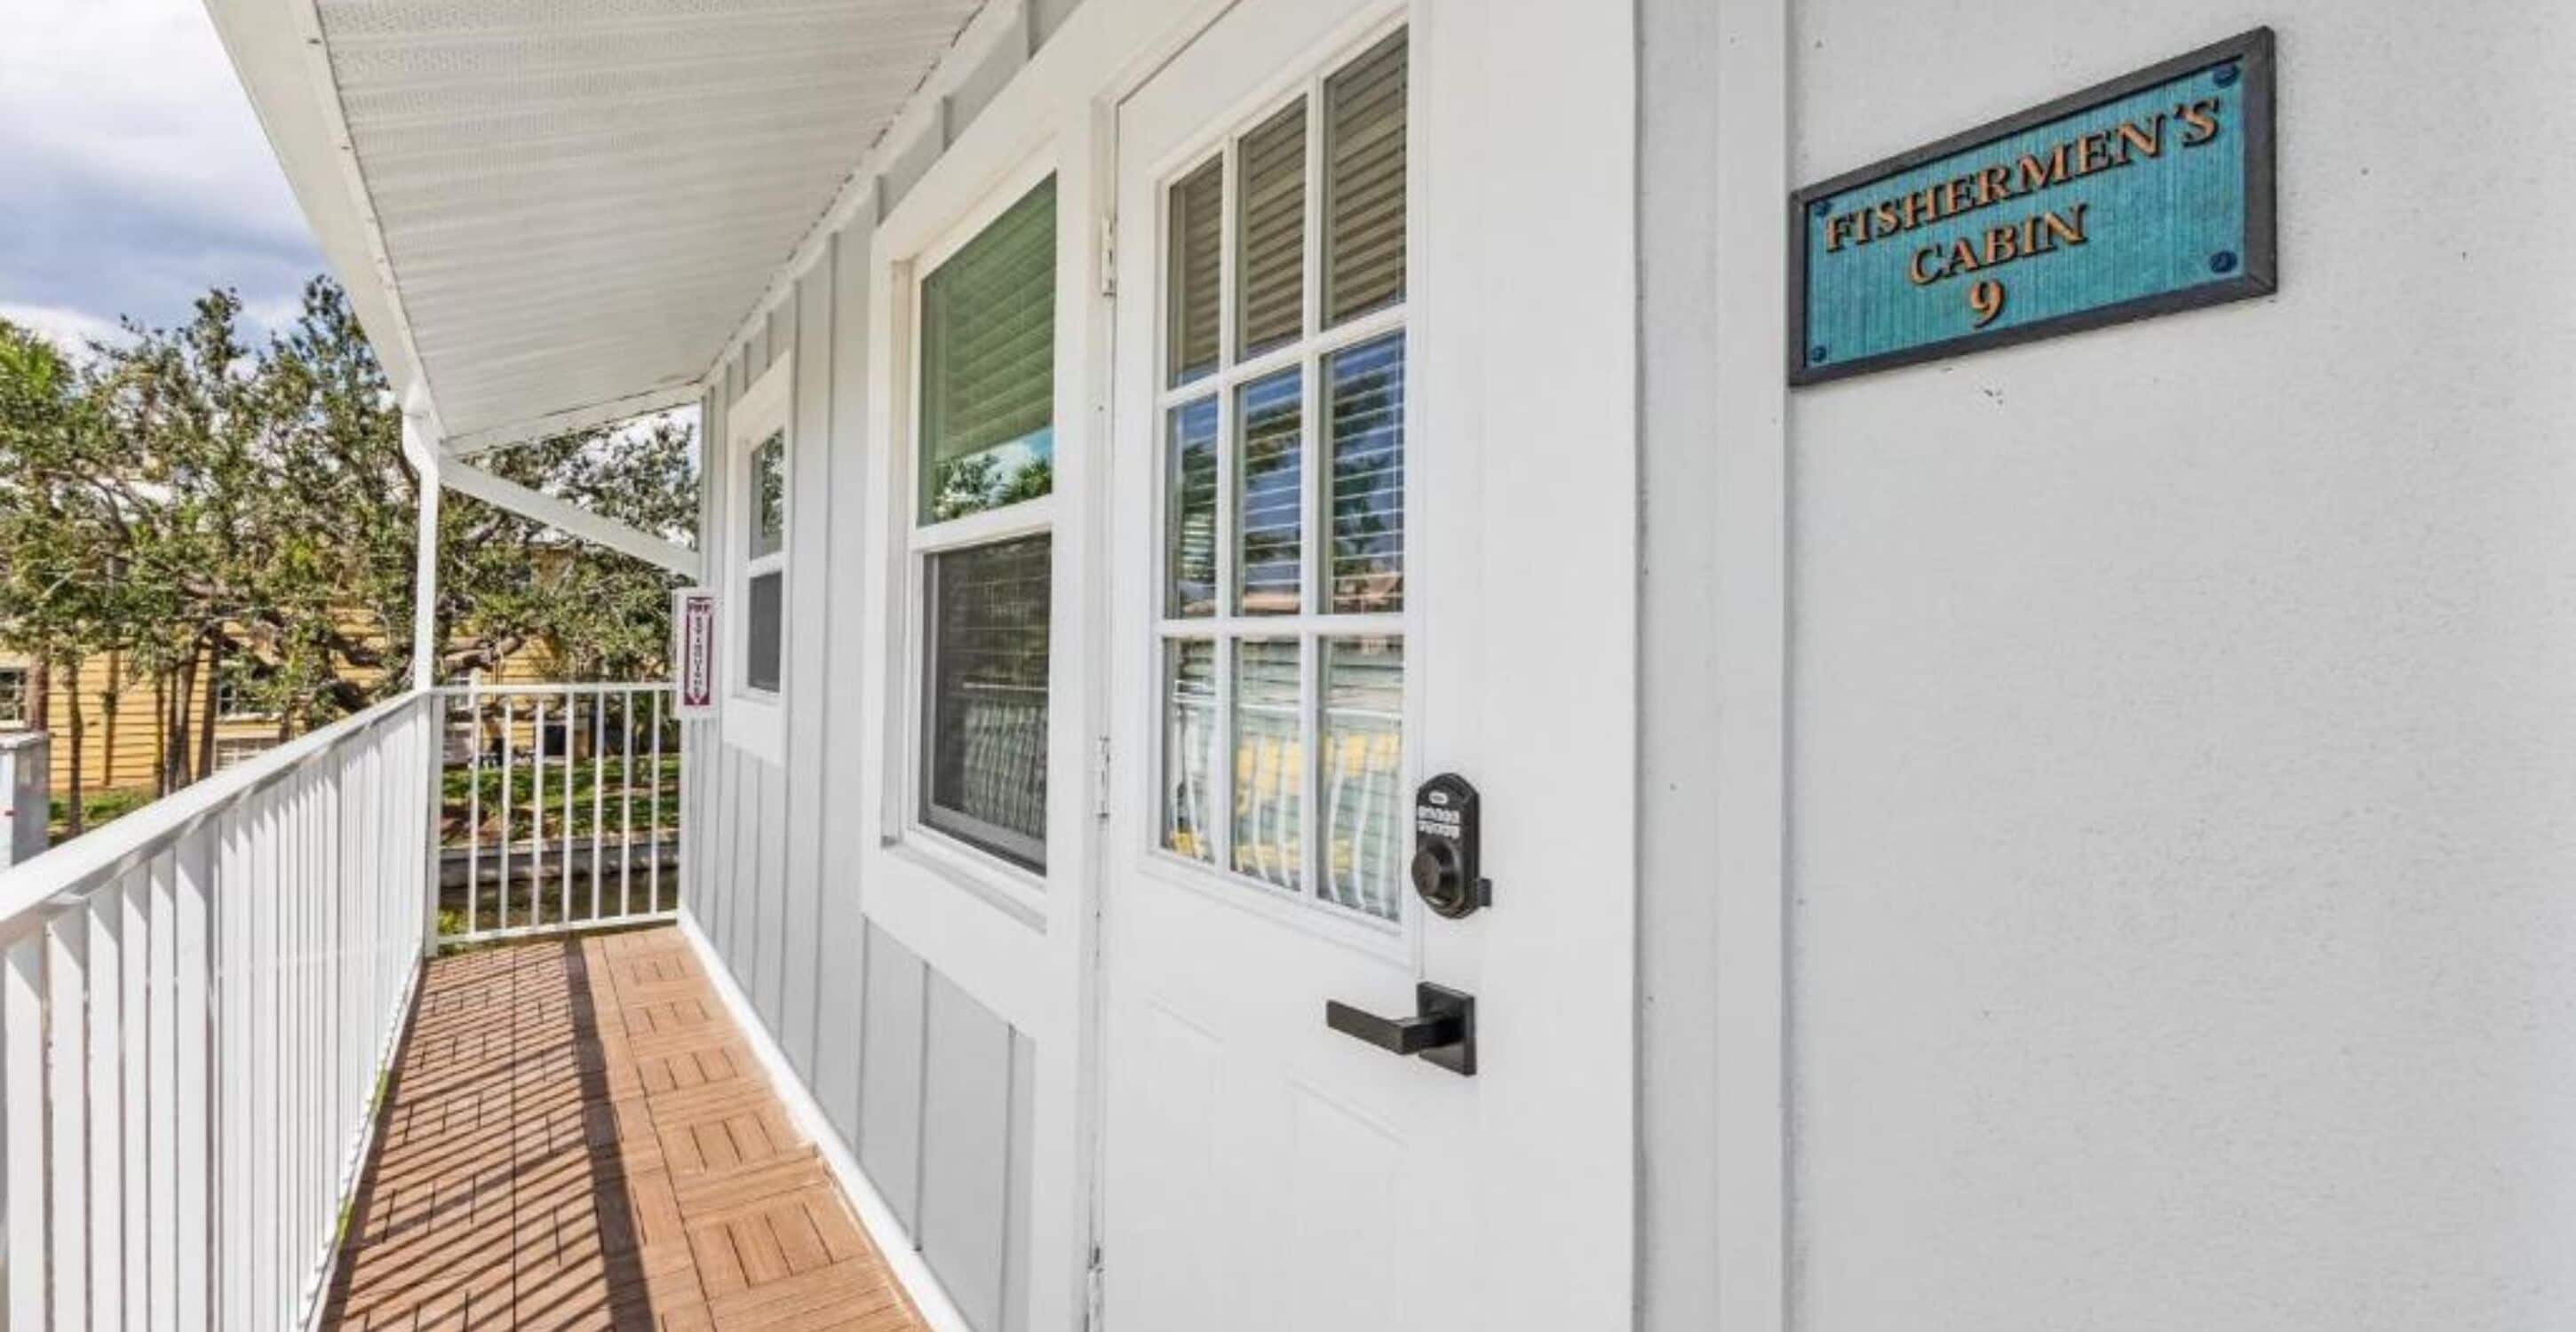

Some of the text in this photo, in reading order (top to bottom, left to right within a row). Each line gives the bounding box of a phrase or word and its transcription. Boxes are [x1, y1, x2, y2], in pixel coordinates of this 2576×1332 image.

[1826, 98, 2219, 253] FISHERMEN'S
[1909, 203, 2087, 285] CABIN
[1969, 278, 2006, 329] 9
